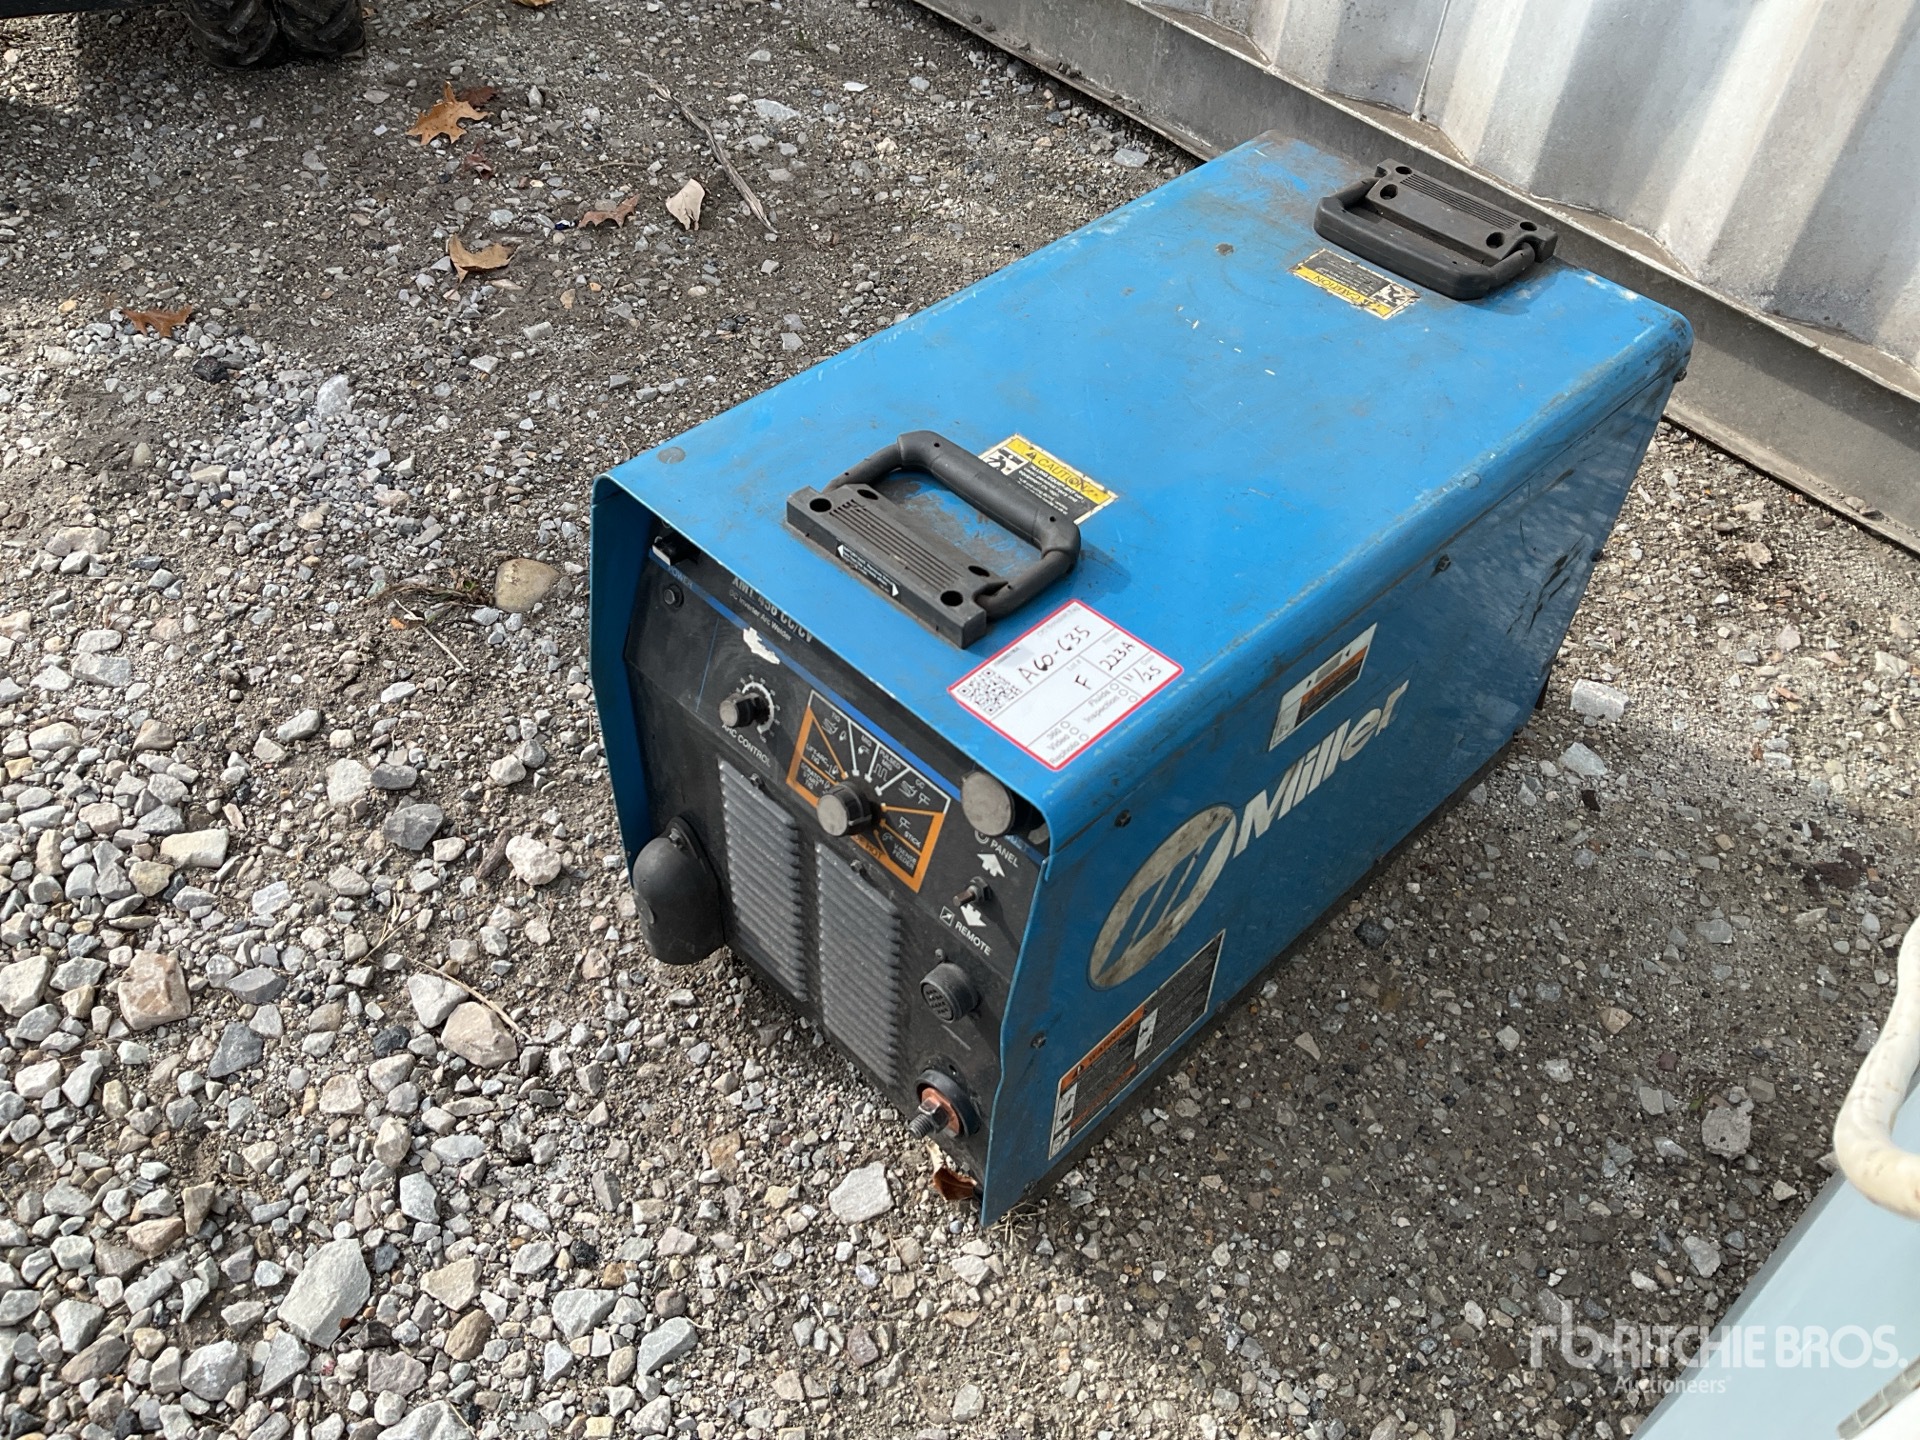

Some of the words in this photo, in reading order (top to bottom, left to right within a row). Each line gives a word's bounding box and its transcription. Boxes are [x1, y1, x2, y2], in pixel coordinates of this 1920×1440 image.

[1312, 274, 1361, 302] CAUTION
[1038, 458, 1087, 492] CAUTION
[739, 596, 761, 617] Inverter
[760, 613, 771, 626] Arc
[771, 621, 792, 642] Welder
[1099, 641, 1136, 671] 223A
[1074, 674, 1092, 690] F
[738, 734, 771, 768] CONTROL
[1233, 680, 1409, 859] Miller
[990, 839, 1018, 868] PANEL
[955, 921, 992, 956] REMOTE
